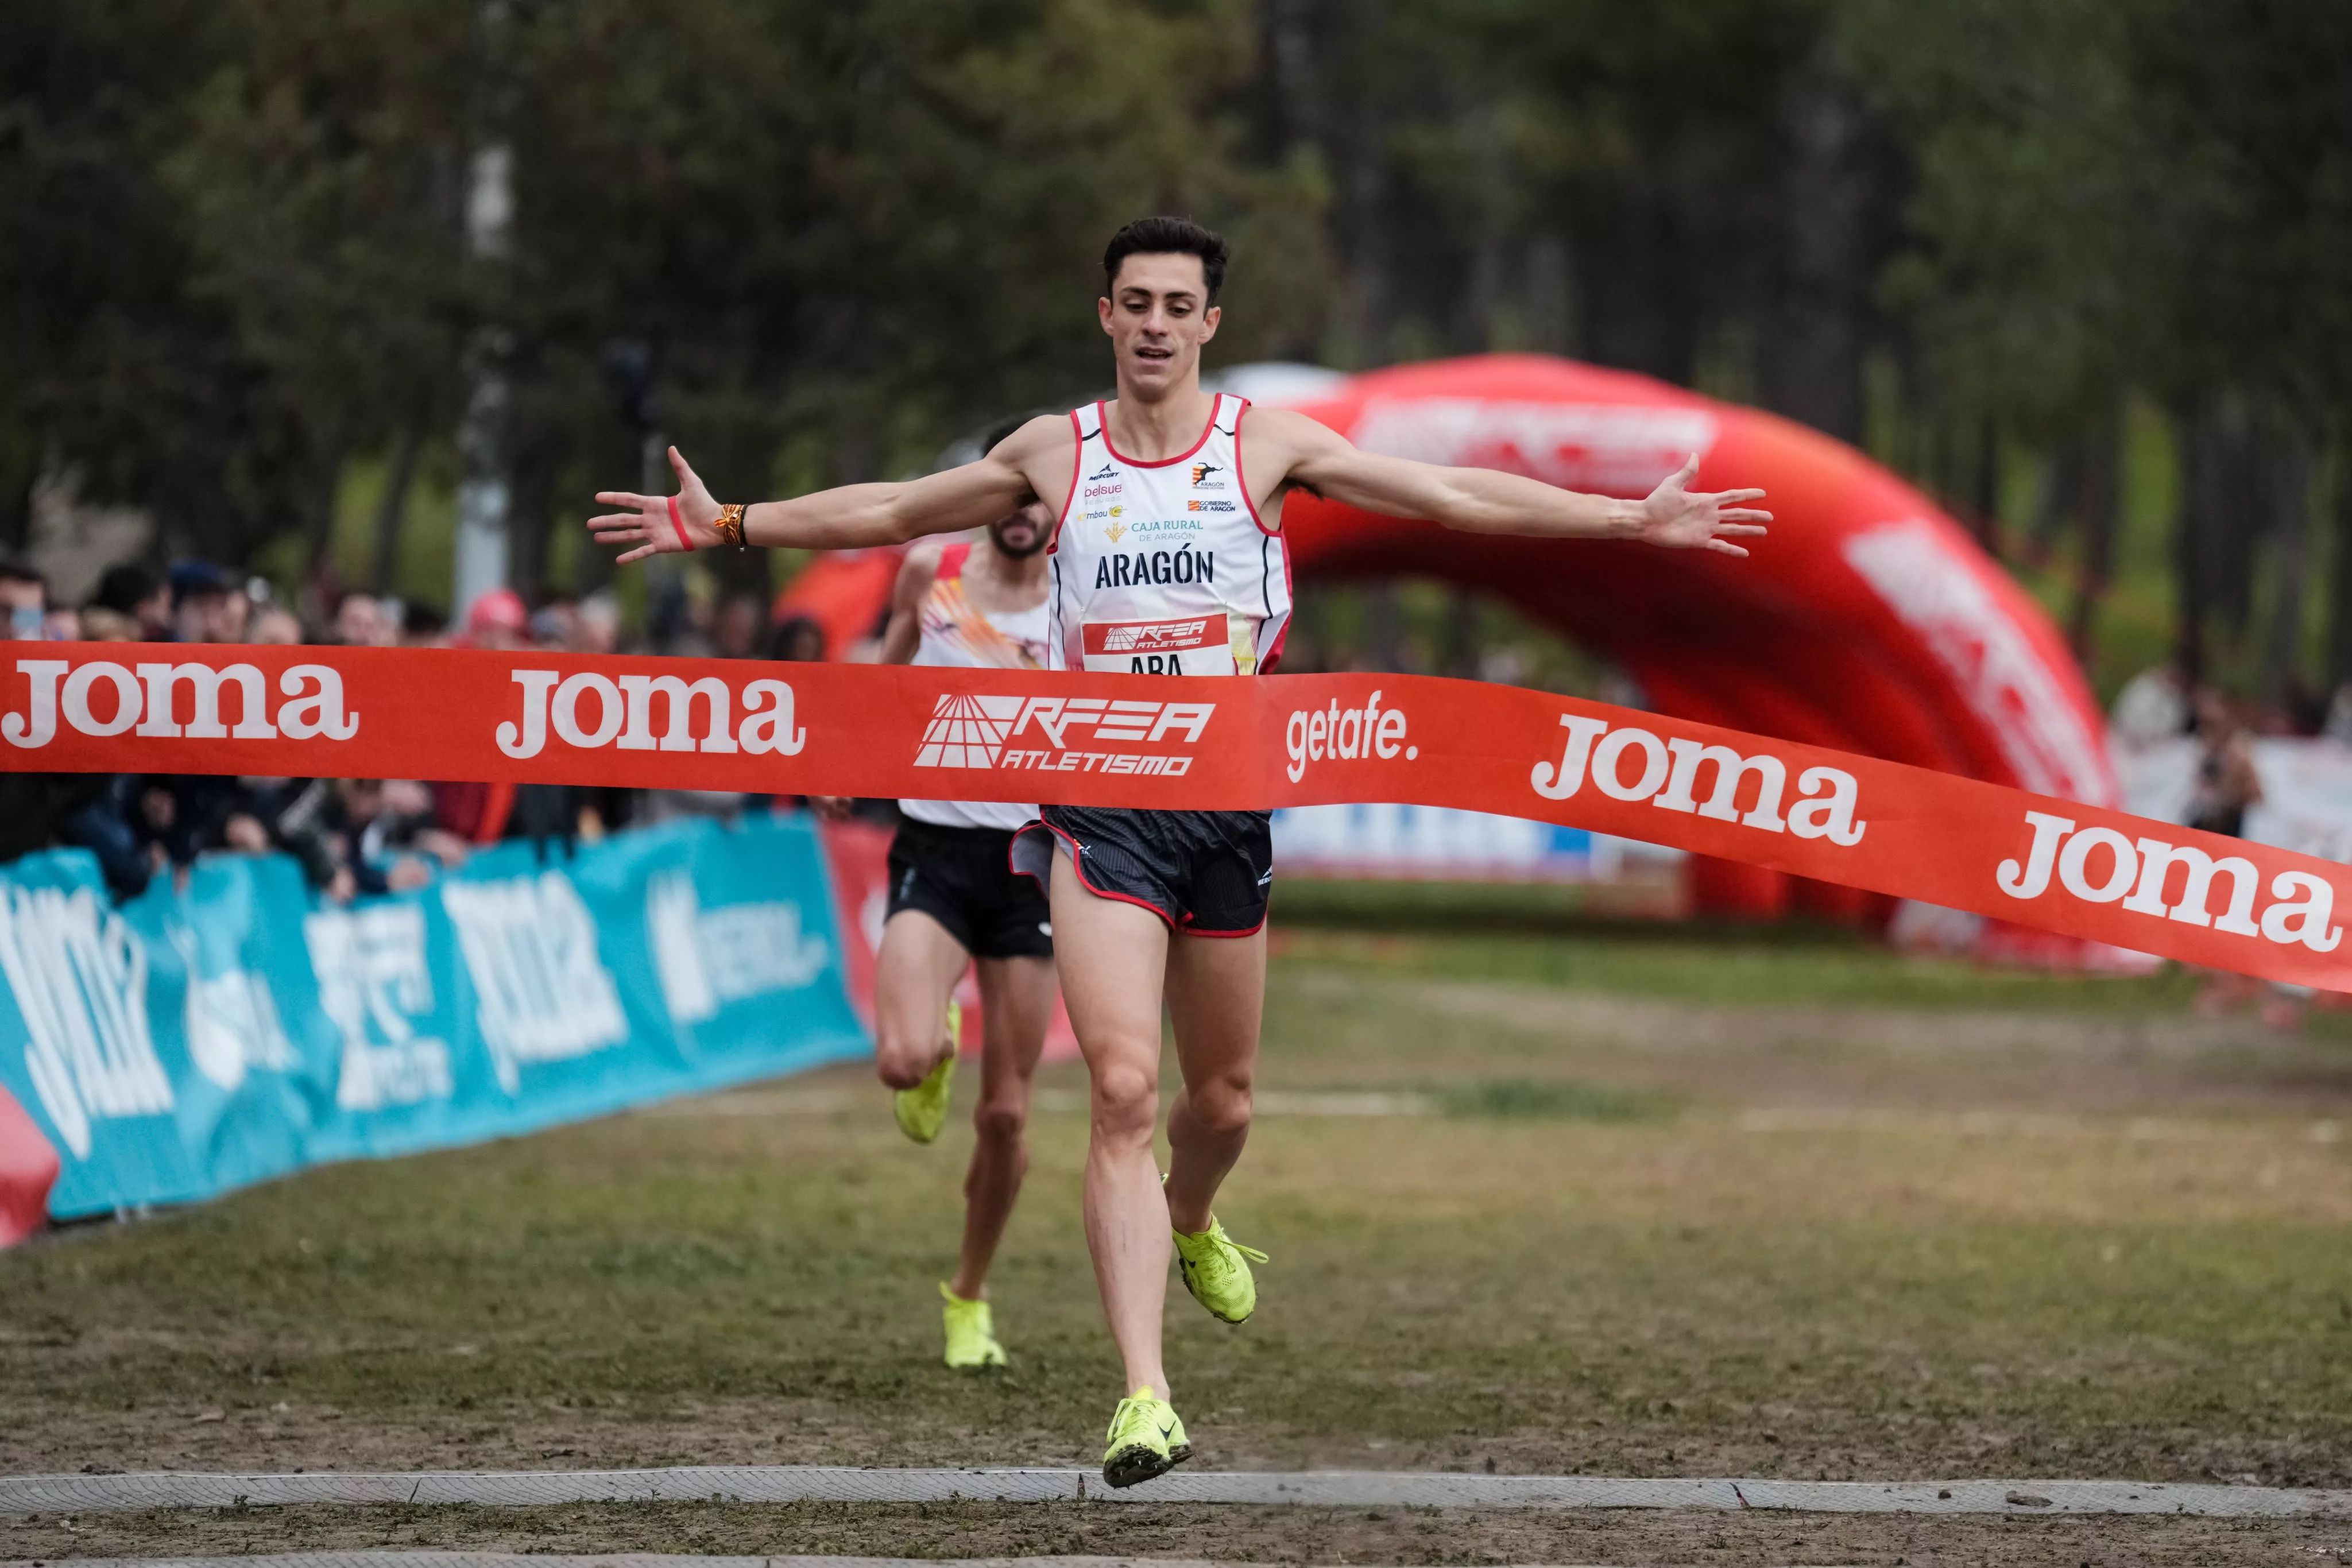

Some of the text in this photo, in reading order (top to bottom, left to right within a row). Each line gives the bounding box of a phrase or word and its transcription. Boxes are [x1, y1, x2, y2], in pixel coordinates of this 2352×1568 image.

[1089, 472, 1119, 481] MERCURY
[1131, 520, 1204, 532] CAJA RURAL
[1154, 532, 1195, 540] ARAGÓN
[1095, 543, 1213, 589] ARAGÓN
[1136, 637, 1202, 648] ATLETISMO
[1139, 621, 1207, 641] RFEA
[1, 660, 359, 748] Joma
[496, 669, 806, 759] Joma
[1012, 697, 1216, 748] RFEA
[1286, 690, 1418, 784] getafe.
[1001, 749, 1194, 776] ATLETISMO
[1531, 714, 1866, 846] Joma
[1996, 810, 2343, 953] Joma
